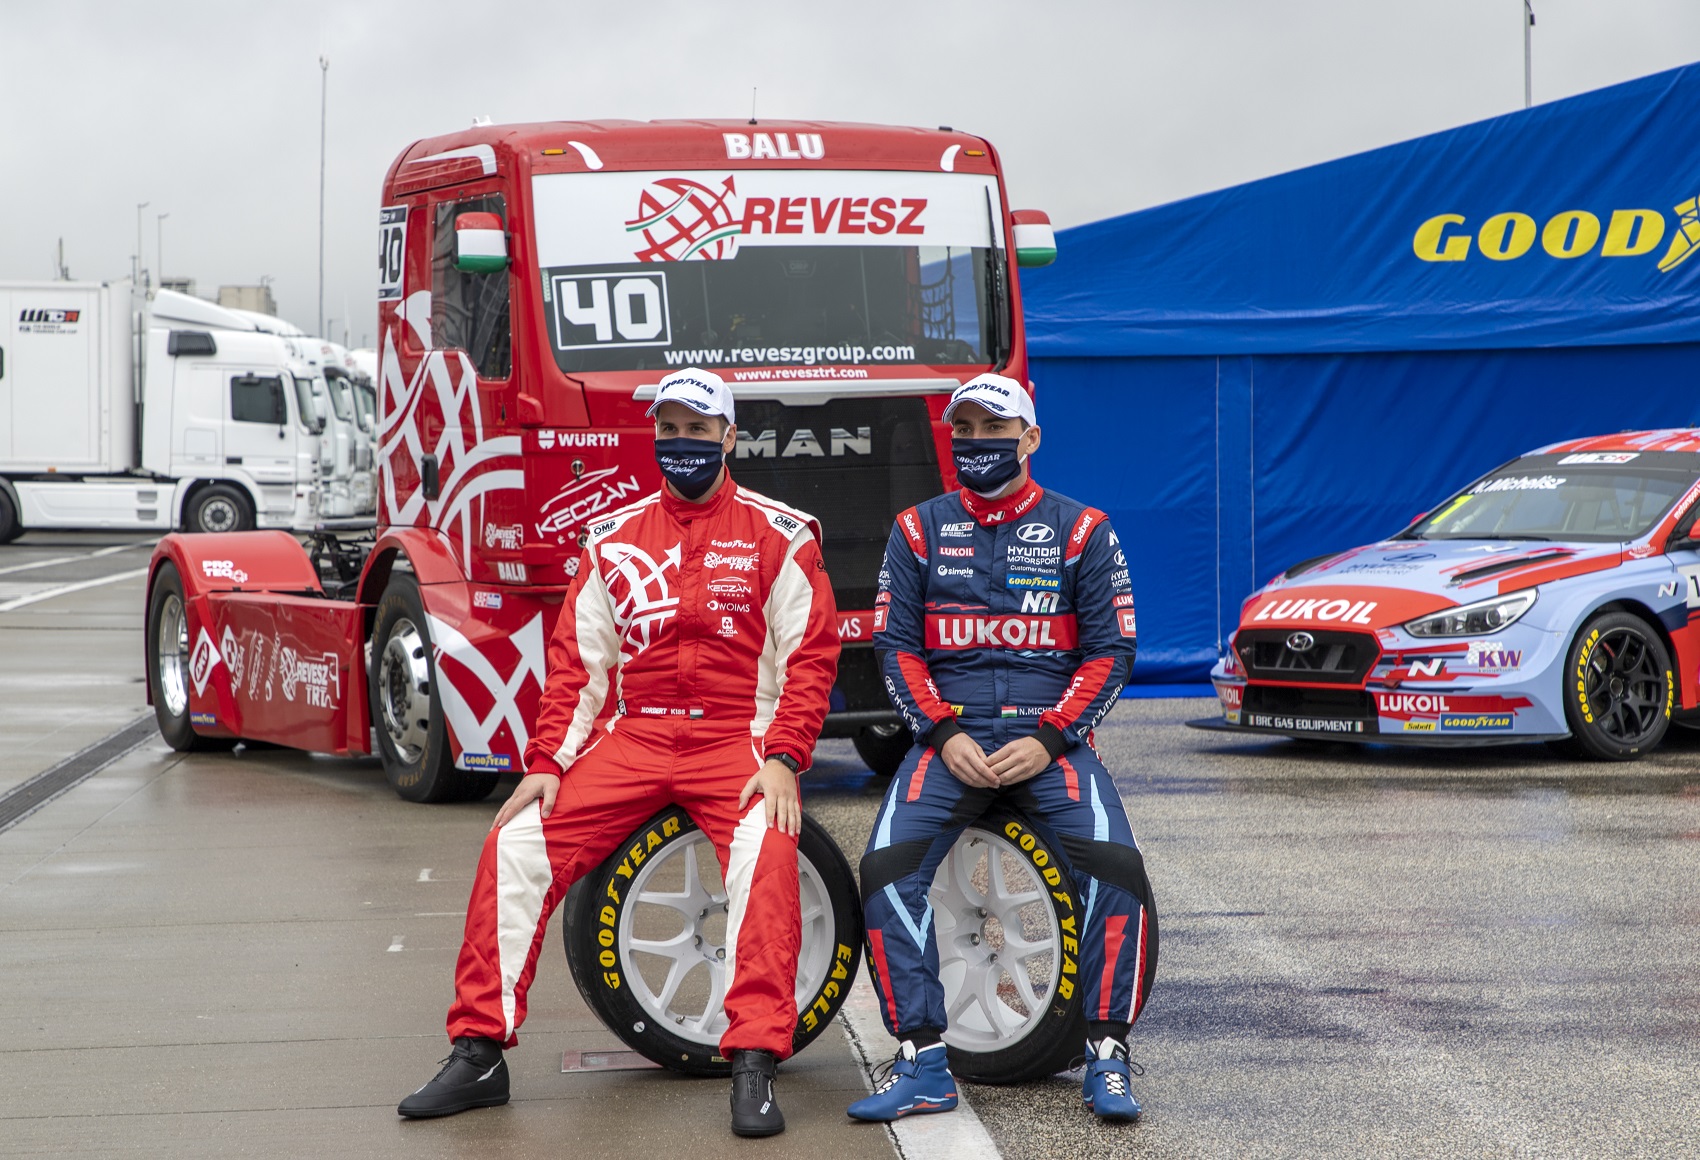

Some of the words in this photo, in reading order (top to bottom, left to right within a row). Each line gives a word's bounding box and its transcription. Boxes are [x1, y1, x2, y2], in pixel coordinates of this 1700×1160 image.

[722, 132, 825, 160] BALU
[741, 197, 928, 235] REVESZ
[560, 278, 663, 341] 40
[664, 345, 915, 365] www.reveszgroup.com
[734, 367, 868, 381] www.revesztrt.com
[558, 433, 619, 447] WÜRTH
[735, 426, 872, 459] MAN
[1430, 495, 1474, 524] 1
[594, 521, 616, 535] OMP
[774, 514, 797, 530] OMP
[904, 513, 920, 541] Sabelt
[1073, 514, 1093, 544] Sabelt
[940, 547, 974, 557] LUKOIL
[1007, 545, 1060, 557] HYUNDAI
[1007, 555, 1060, 565] MOTORSPORT
[497, 561, 527, 582] BALU
[948, 567, 974, 576] simple
[1008, 577, 1059, 587] GOODYEAR
[719, 603, 750, 613] WOIMS
[1253, 599, 1378, 624] LUKOIL
[938, 618, 1056, 646] LUKOIL
[1478, 650, 1522, 668] KW
[297, 661, 329, 686] REVESZ
[1577, 629, 1599, 723] GOODYEAR
[640, 706, 667, 715] NORBERT
[1091, 683, 1123, 727] HYUNDAI
[1379, 694, 1450, 712] LUKOIL
[1256, 715, 1273, 727] BRC
[1275, 717, 1294, 729] GAS
[1296, 719, 1353, 732] EQUIPMENT
[1444, 716, 1510, 729] GOODYEAR
[465, 755, 510, 767] GOODYEAR
[598, 816, 680, 990] GOODYEAR
[1005, 821, 1080, 1000] GOODYEAR
[802, 942, 852, 1033] EAGLE
